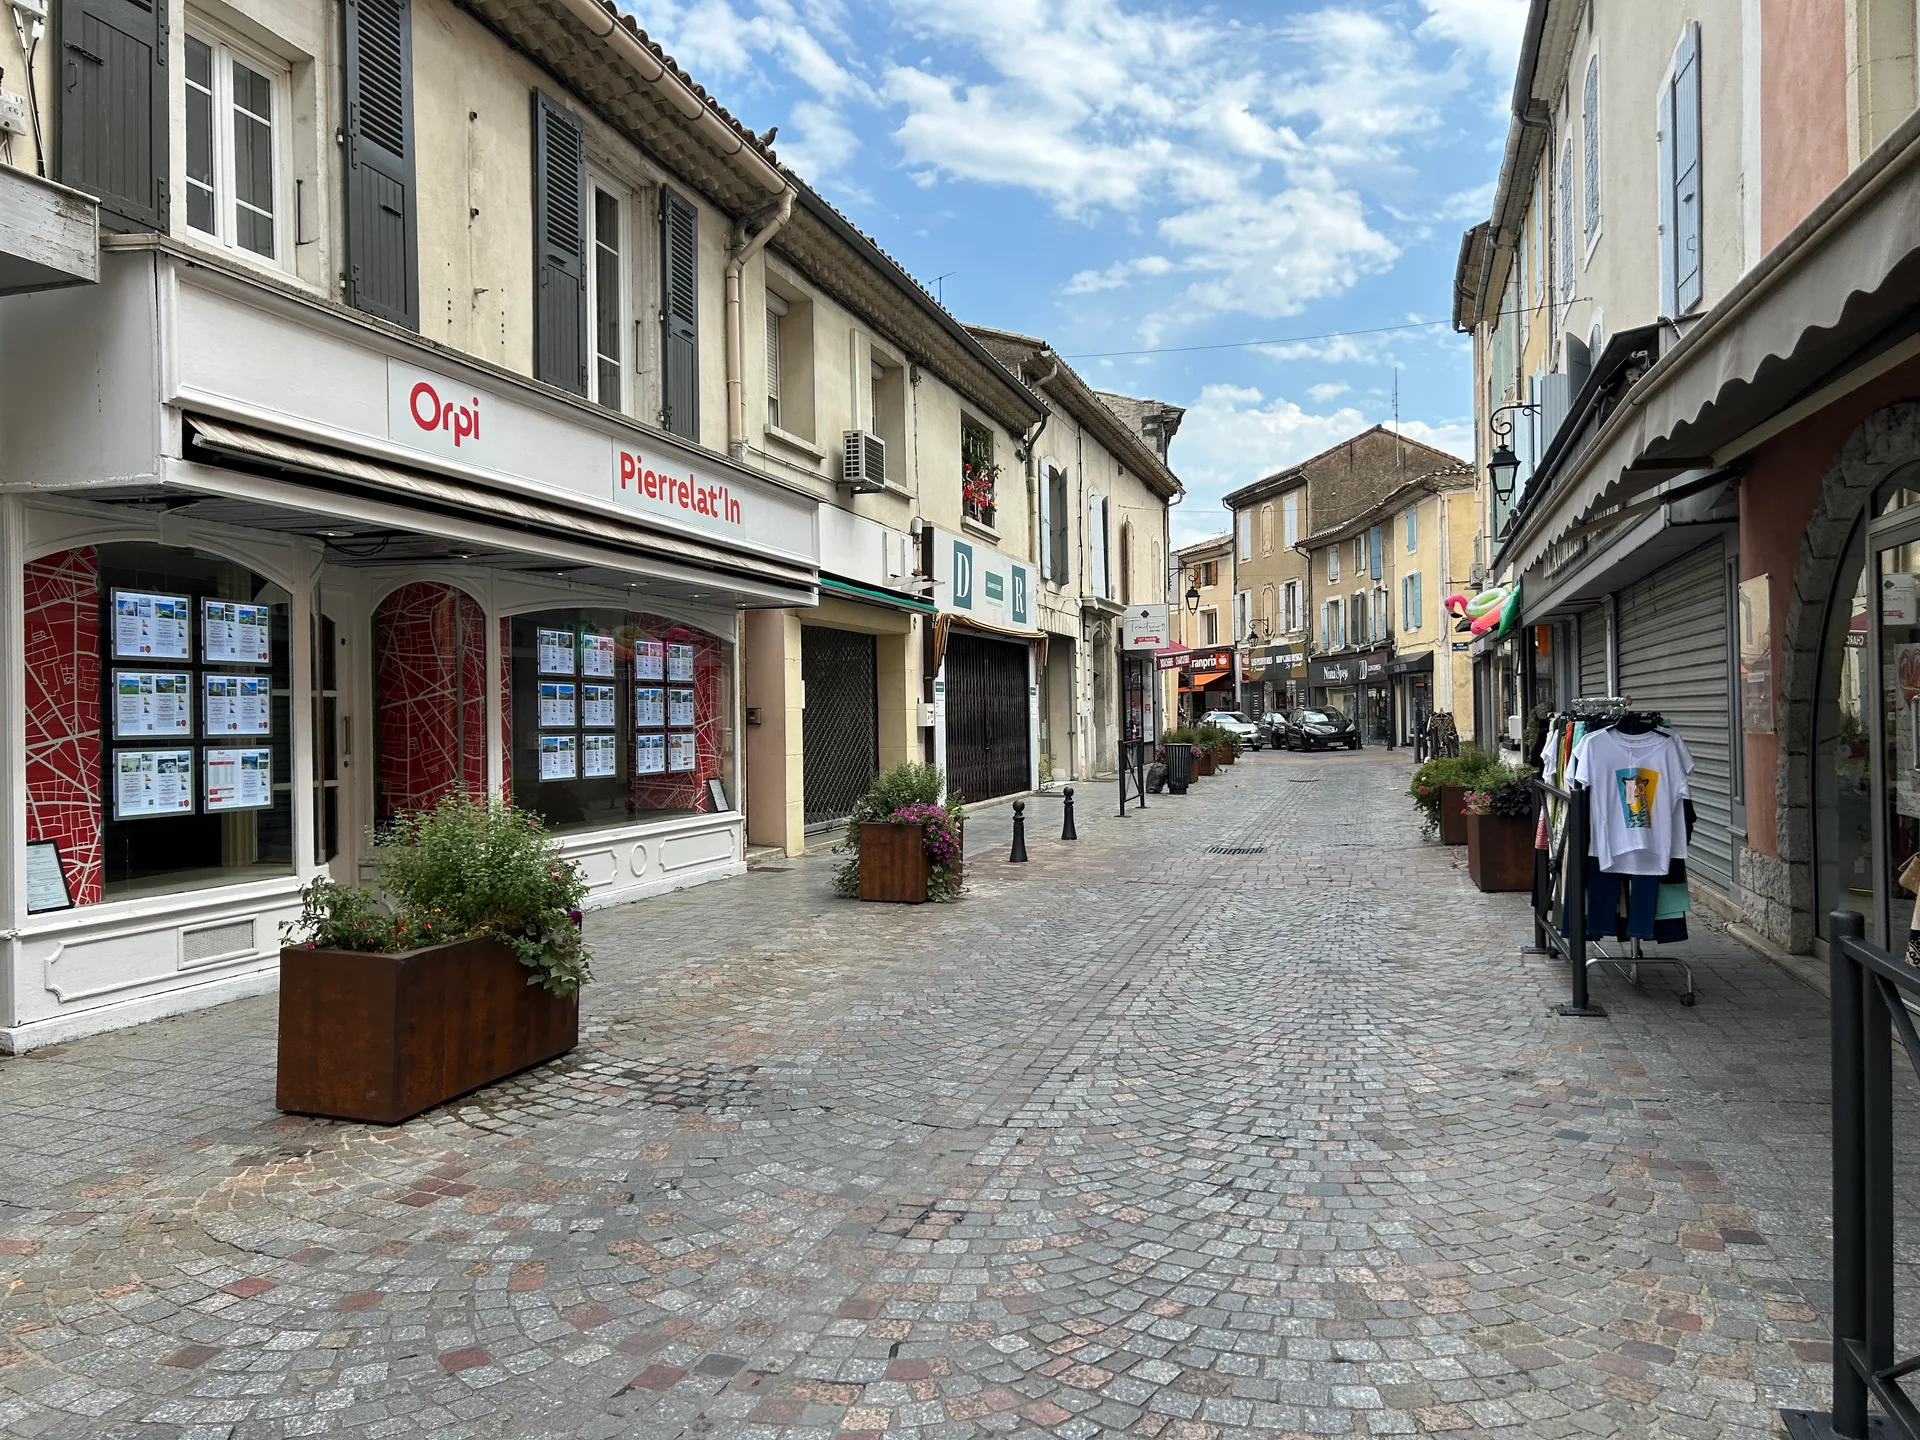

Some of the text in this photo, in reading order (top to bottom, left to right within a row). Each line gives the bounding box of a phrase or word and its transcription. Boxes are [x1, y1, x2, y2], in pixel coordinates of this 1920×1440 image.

[410, 382, 479, 448] Orpi
[620, 451, 741, 525] Pierrelat'In
[956, 551, 970, 598] D
[1014, 575, 1025, 614] R
[1191, 654, 1216, 669] ranprix
